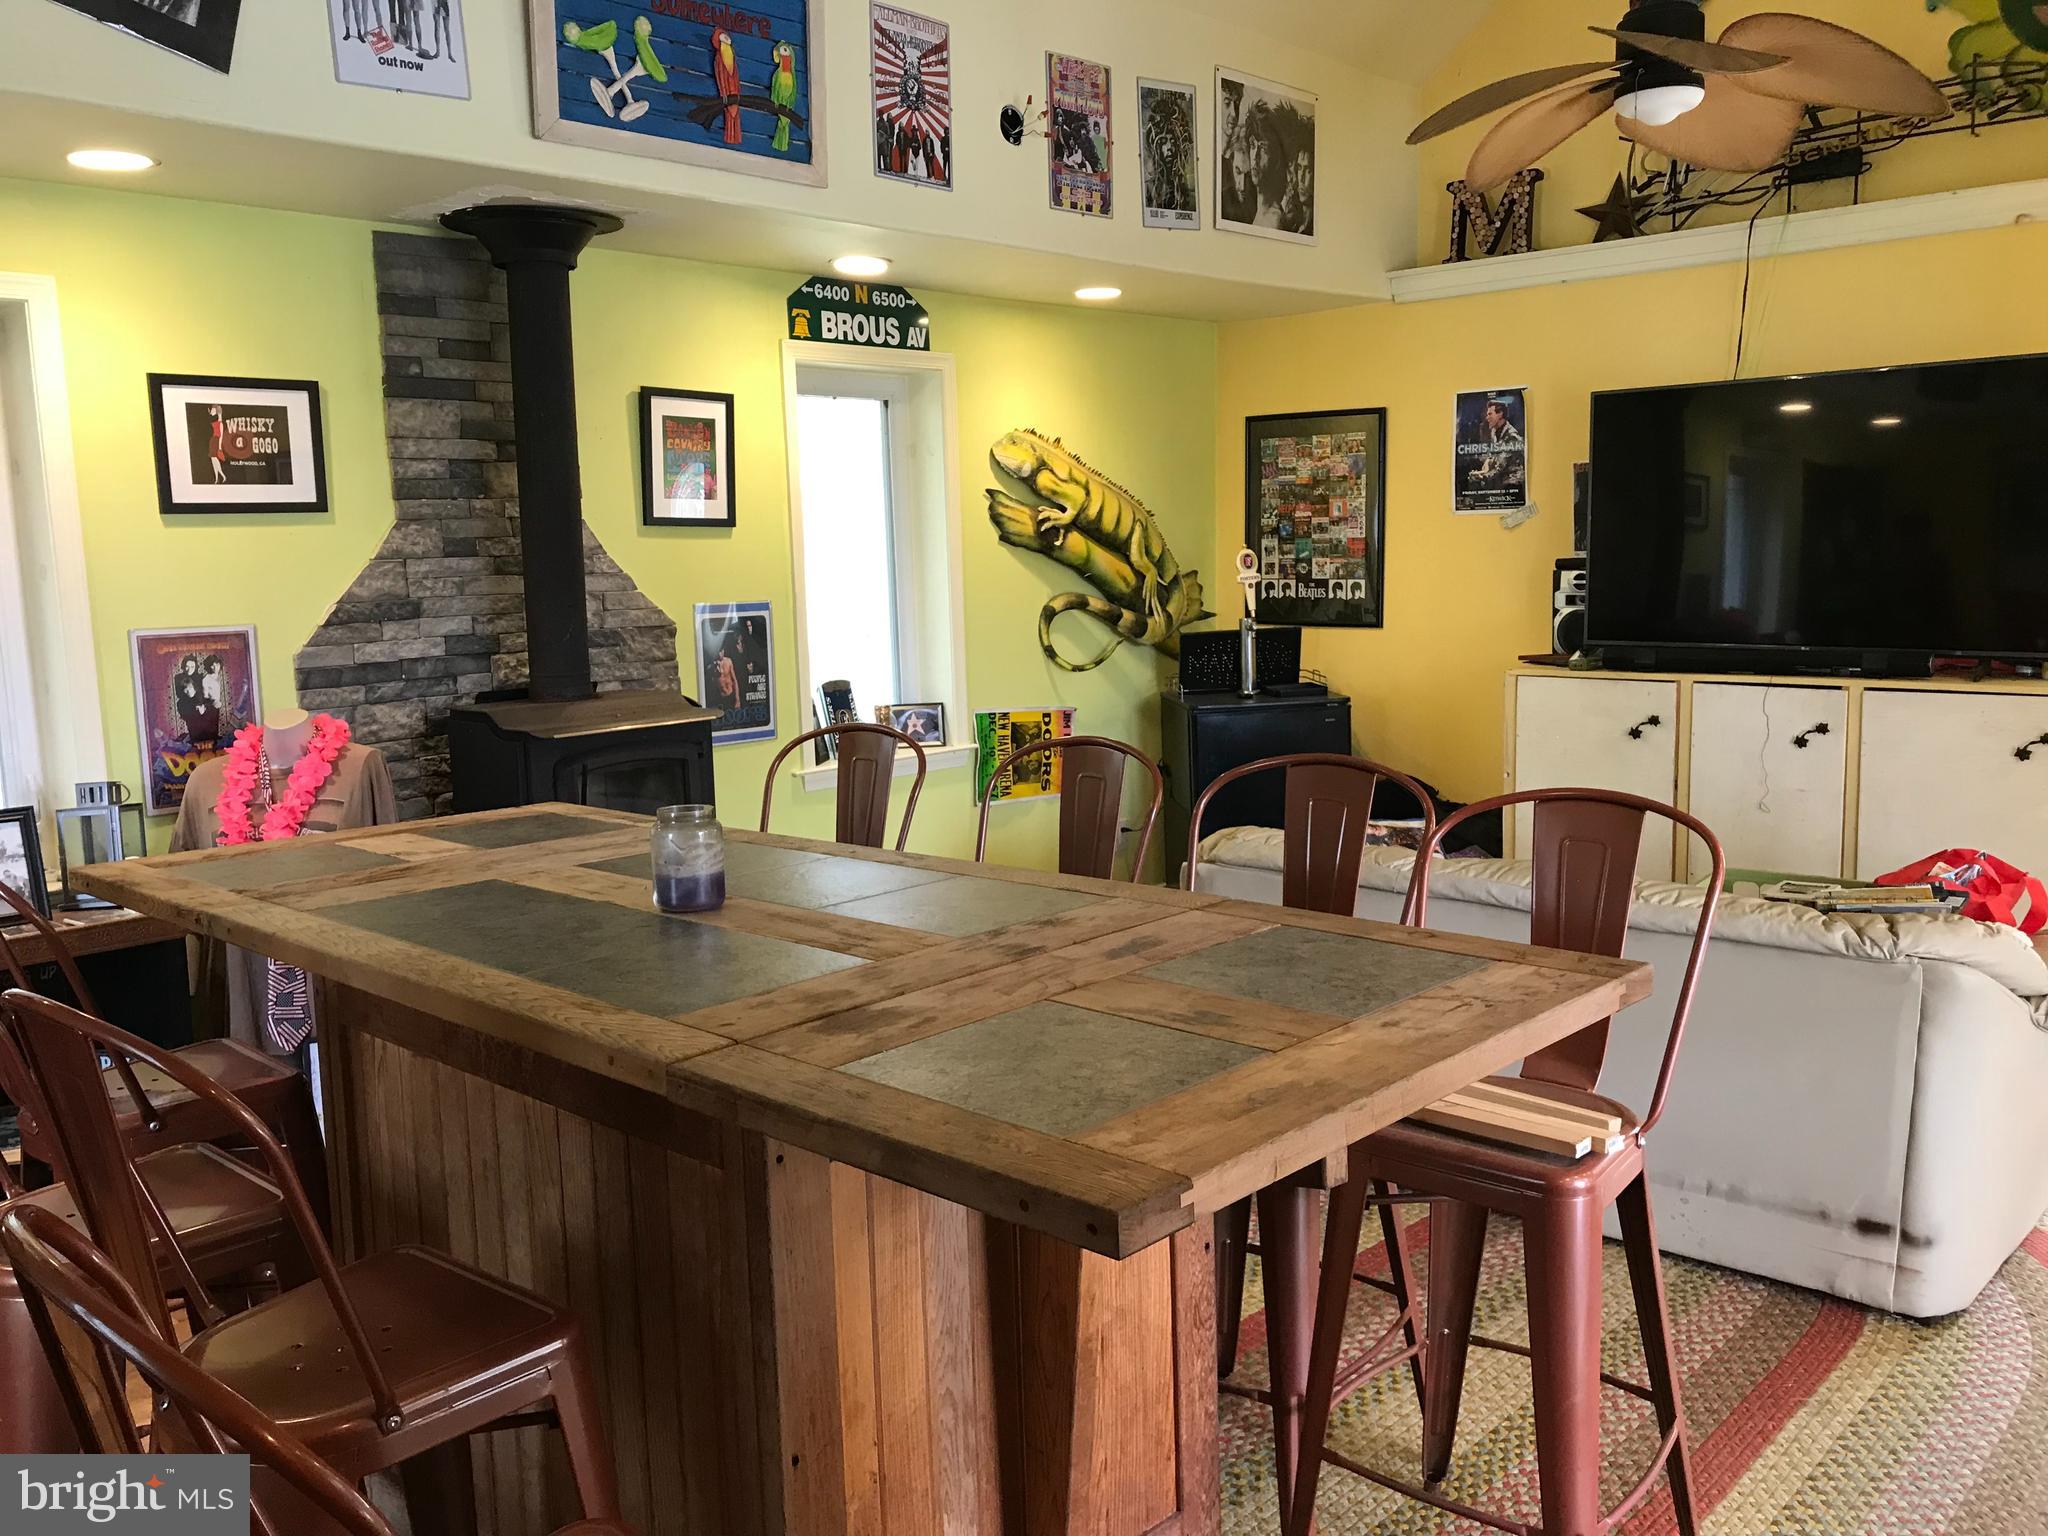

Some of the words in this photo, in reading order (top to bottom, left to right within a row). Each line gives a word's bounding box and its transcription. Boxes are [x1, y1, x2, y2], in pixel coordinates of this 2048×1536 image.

[378, 56, 398, 67] out
[399, 59, 424, 72] now
[814, 283, 850, 301] 6400
[854, 284, 868, 304] N
[872, 291, 906, 308] 6500
[821, 310, 900, 346] BROUS
[906, 326, 927, 348] AV
[226, 417, 275, 434] WHISKY
[252, 437, 279, 454] GOGO
[1457, 443, 1488, 455] CHRIS
[1489, 441, 1523, 453] ISAAK
[1298, 582, 1327, 600] BEATLES
[998, 712, 1010, 730] NEW
